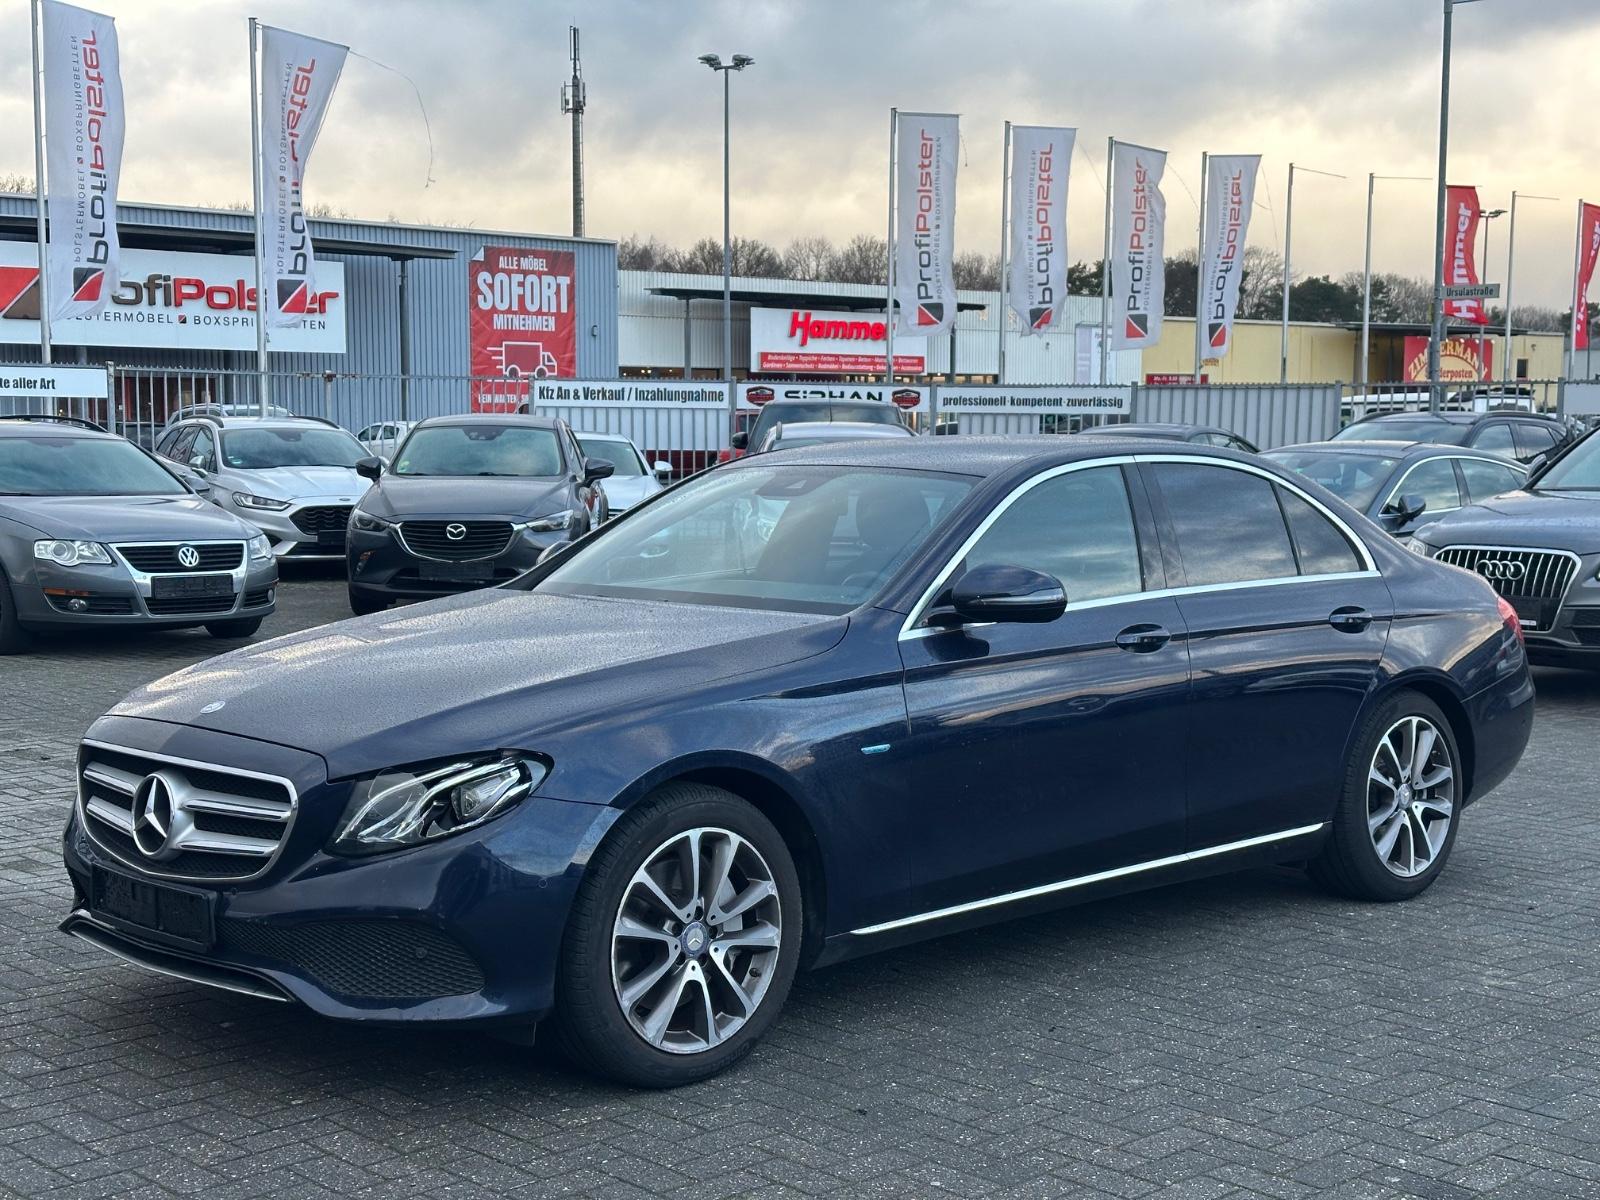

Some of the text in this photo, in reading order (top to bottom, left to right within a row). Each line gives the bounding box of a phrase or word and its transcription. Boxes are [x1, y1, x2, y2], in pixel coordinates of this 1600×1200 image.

[915, 128, 934, 300] ProfiPolster
[1127, 157, 1148, 311] ProfiPolster
[499, 255, 548, 271] ALLE MÖBEL
[1452, 202, 1478, 319] Hmmer
[111, 273, 339, 314] ofiPolsr
[477, 271, 570, 313] SOFORT
[1446, 286, 1494, 297] Ursulastraße
[67, 311, 326, 330] STERMÖBEL BOXSPRITEN
[493, 314, 555, 331] MITNEHMEN
[789, 310, 895, 346] Hamme
[1408, 341, 1488, 379] ZIMERMANN
[12, 377, 37, 389] aller
[40, 378, 56, 389] Art
[1440, 367, 1473, 380] derposten
[538, 386, 554, 400] Kfz
[557, 386, 570, 400] An
[573, 388, 580, 400] &
[583, 386, 625, 401] Verkauf
[635, 387, 724, 403] Inzahlungnahme
[942, 395, 1123, 409] professionell kompetent zuverlässig
